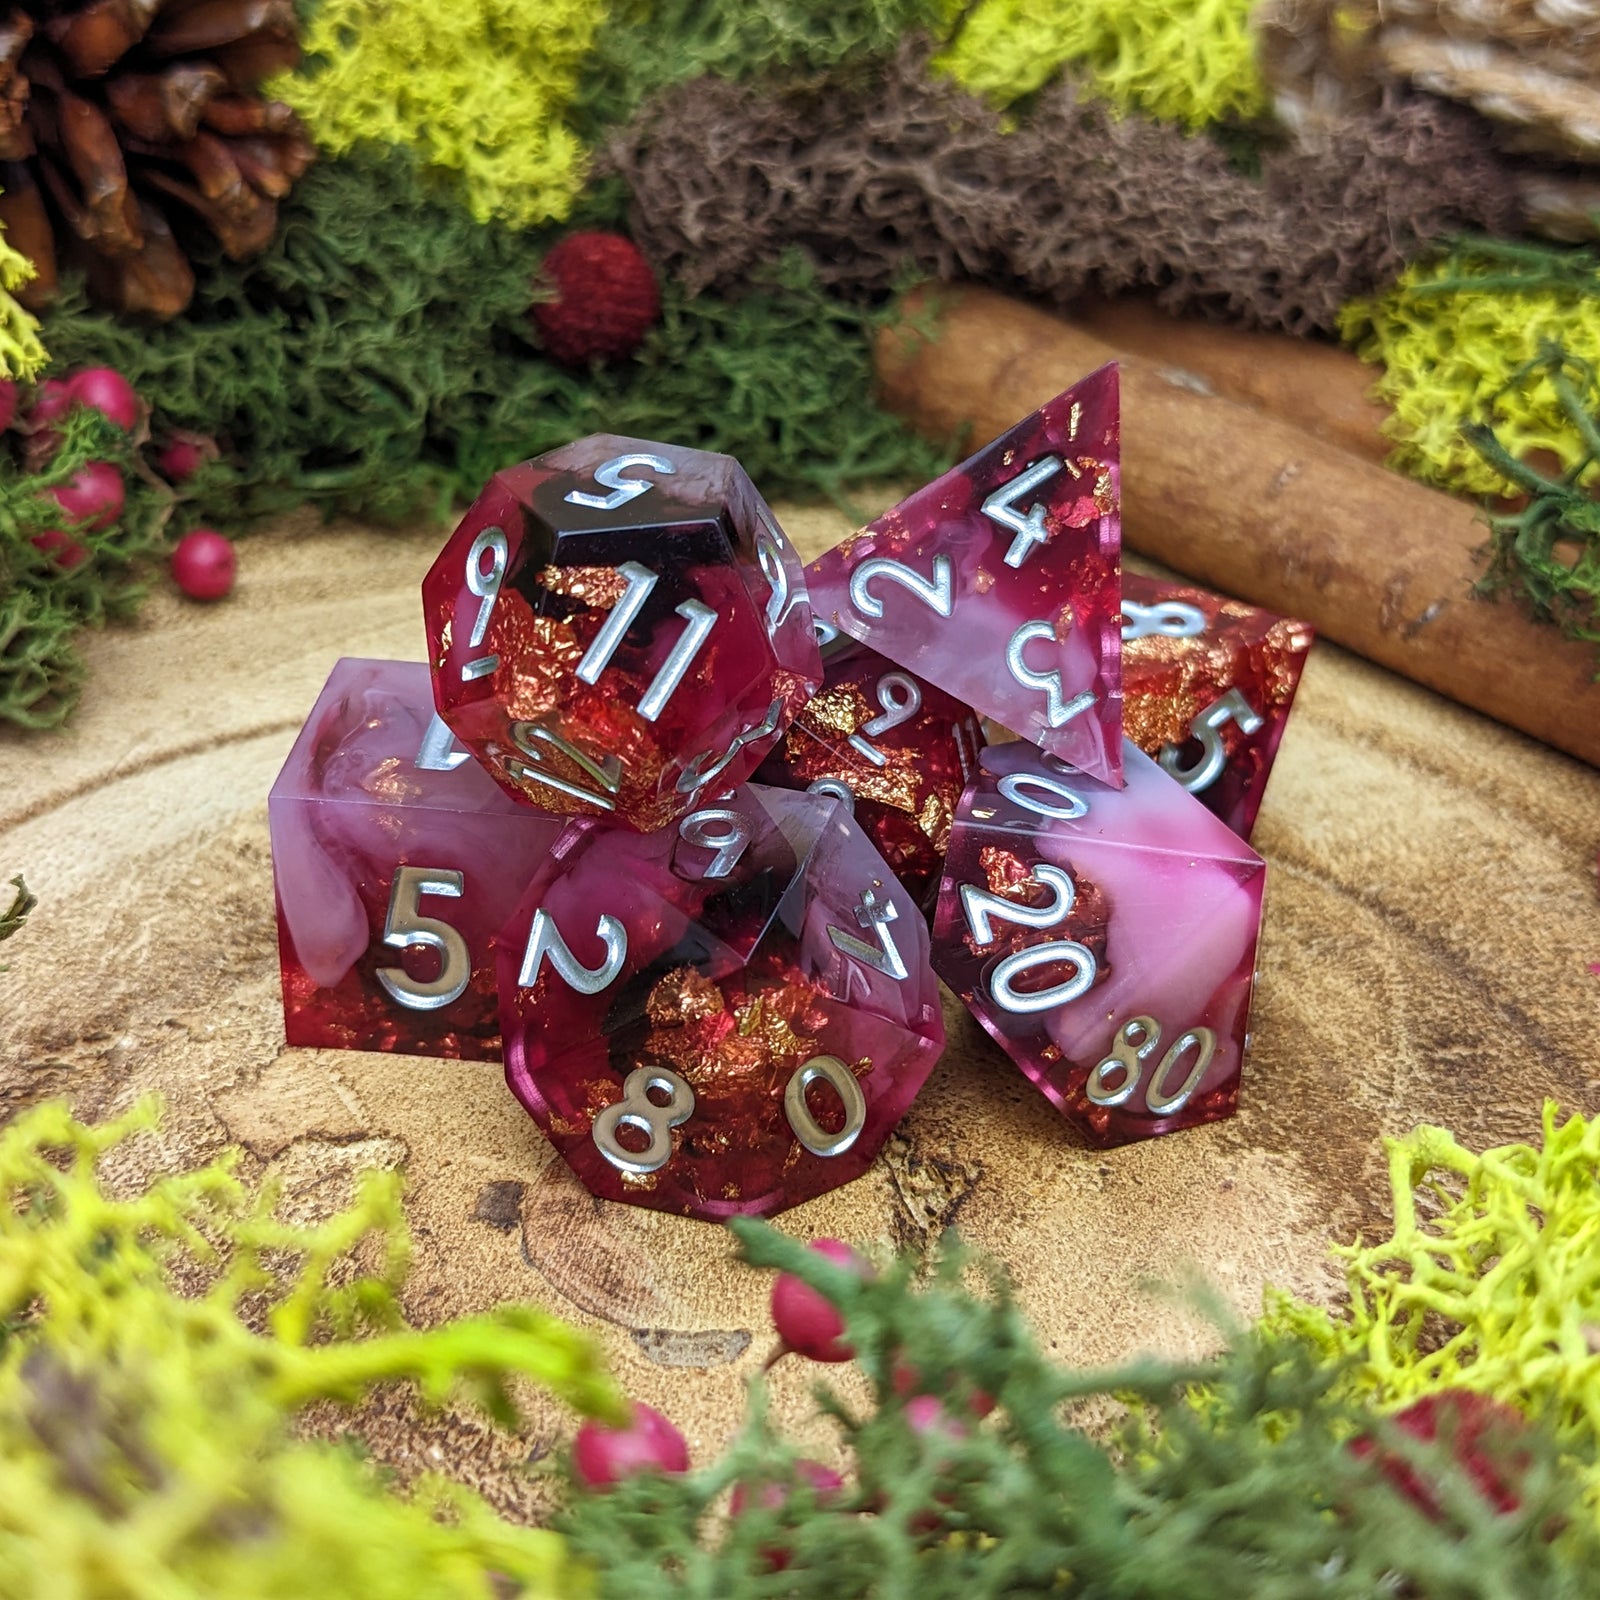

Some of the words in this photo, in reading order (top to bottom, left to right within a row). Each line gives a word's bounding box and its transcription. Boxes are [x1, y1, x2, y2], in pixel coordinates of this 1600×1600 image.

[564, 452, 677, 510] 5
[981, 455, 1064, 569] 4
[849, 554, 954, 619] 2
[574, 560, 719, 722] 11
[1005, 619, 1099, 729] 3
[1158, 687, 1265, 794] 5
[375, 866, 472, 1010] 5
[517, 908, 628, 995] 2
[960, 864, 1097, 1015] 20
[592, 1065, 696, 1173] 8
[784, 1055, 867, 1157] 0
[1086, 1015, 1217, 1116] 80
